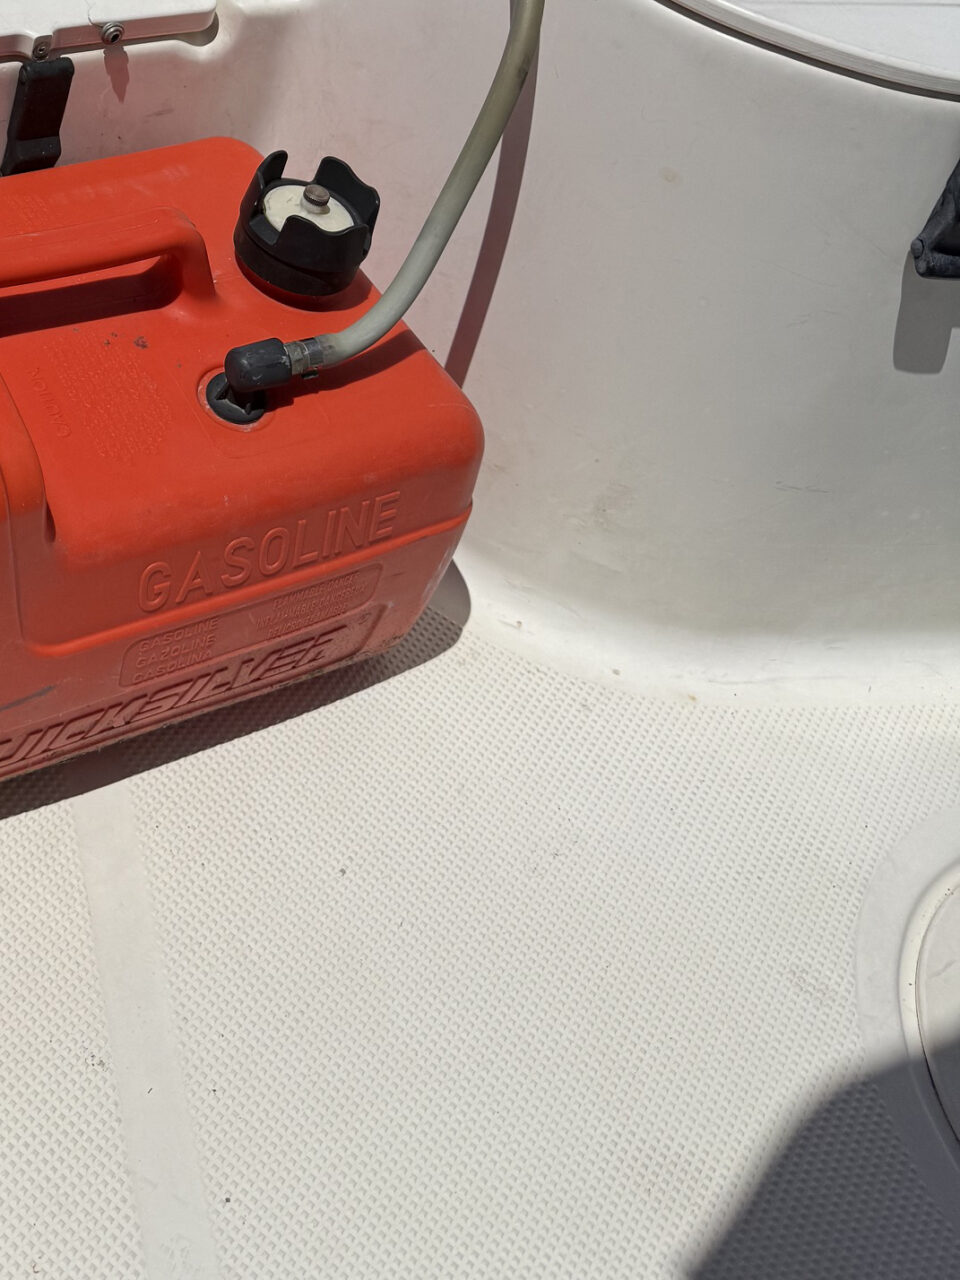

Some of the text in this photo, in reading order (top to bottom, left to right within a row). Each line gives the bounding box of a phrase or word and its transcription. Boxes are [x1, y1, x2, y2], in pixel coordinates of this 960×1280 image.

[138, 490, 401, 612] GASOLINE
[139, 617, 219, 651] GASOLINE
[133, 651, 213, 682] GASOLINA
